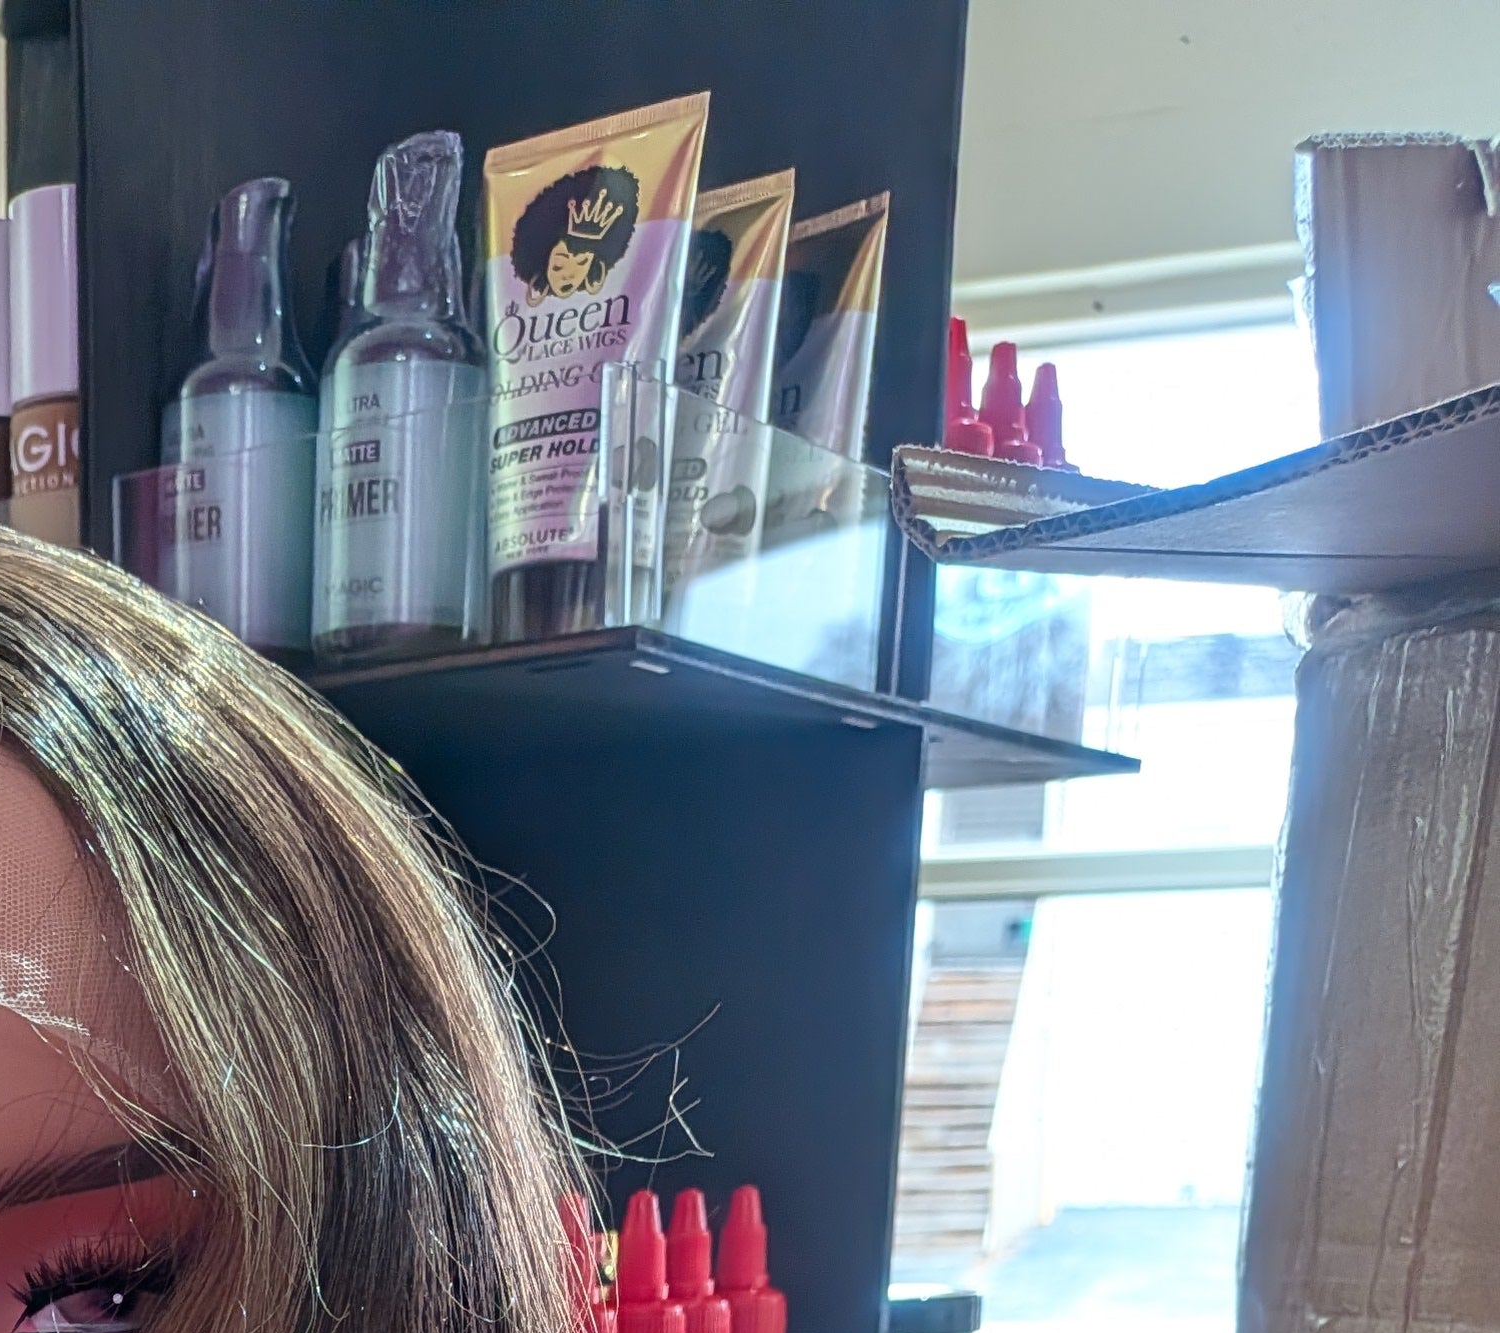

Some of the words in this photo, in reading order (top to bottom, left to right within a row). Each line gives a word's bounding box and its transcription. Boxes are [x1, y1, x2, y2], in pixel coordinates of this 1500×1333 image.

[493, 294, 631, 364] Queen
[527, 338, 573, 361] LACE
[577, 328, 627, 350] WIGS
[489, 444, 544, 474] SUPER
[547, 438, 600, 460] HOLD
[320, 479, 399, 525] PRMER
[495, 528, 570, 553] ABSOLUTE
